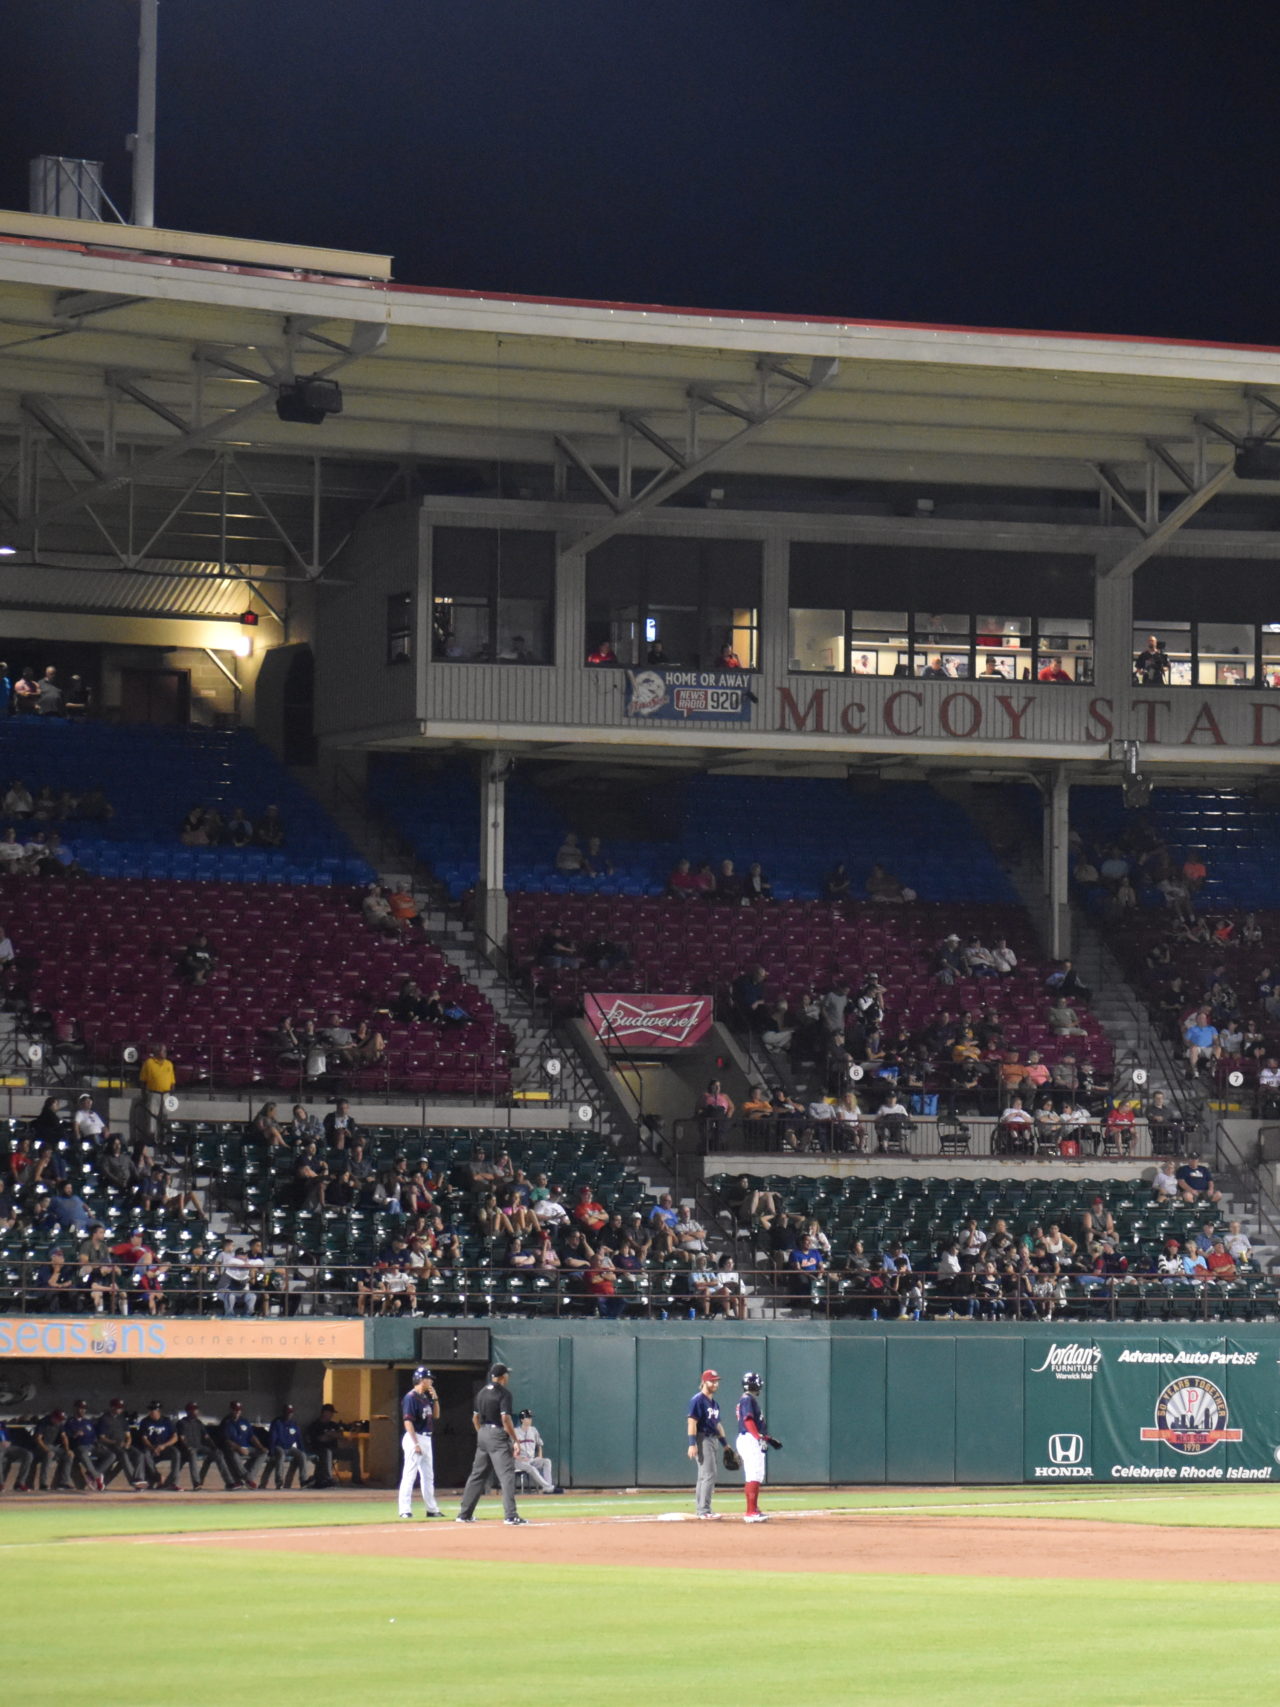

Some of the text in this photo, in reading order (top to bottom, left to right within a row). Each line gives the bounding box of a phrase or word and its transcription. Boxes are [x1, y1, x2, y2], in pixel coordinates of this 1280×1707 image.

[665, 672, 750, 687] HOME OR AWAY
[680, 690, 705, 699] NEWS
[711, 692, 739, 710] 920
[678, 699, 706, 709] RADIO
[777, 686, 1036, 739] McCOY
[598, 1009, 698, 1028] Budweiser
[173, 1333, 337, 1346] corner market
[1031, 1343, 1102, 1372] Jordan's
[1118, 1350, 1174, 1364] Advance
[1051, 1364, 1098, 1372] FURNITURE
[1055, 1372, 1079, 1380] Warwick
[1158, 1379, 1226, 1417] 50 YEARS TOGETHER
[1186, 1389, 1199, 1414] P
[1183, 1443, 1201, 1452] 1970
[1035, 1467, 1093, 1477] HONDA
[1111, 1465, 1272, 1480] Celebrate Rhode Island!
